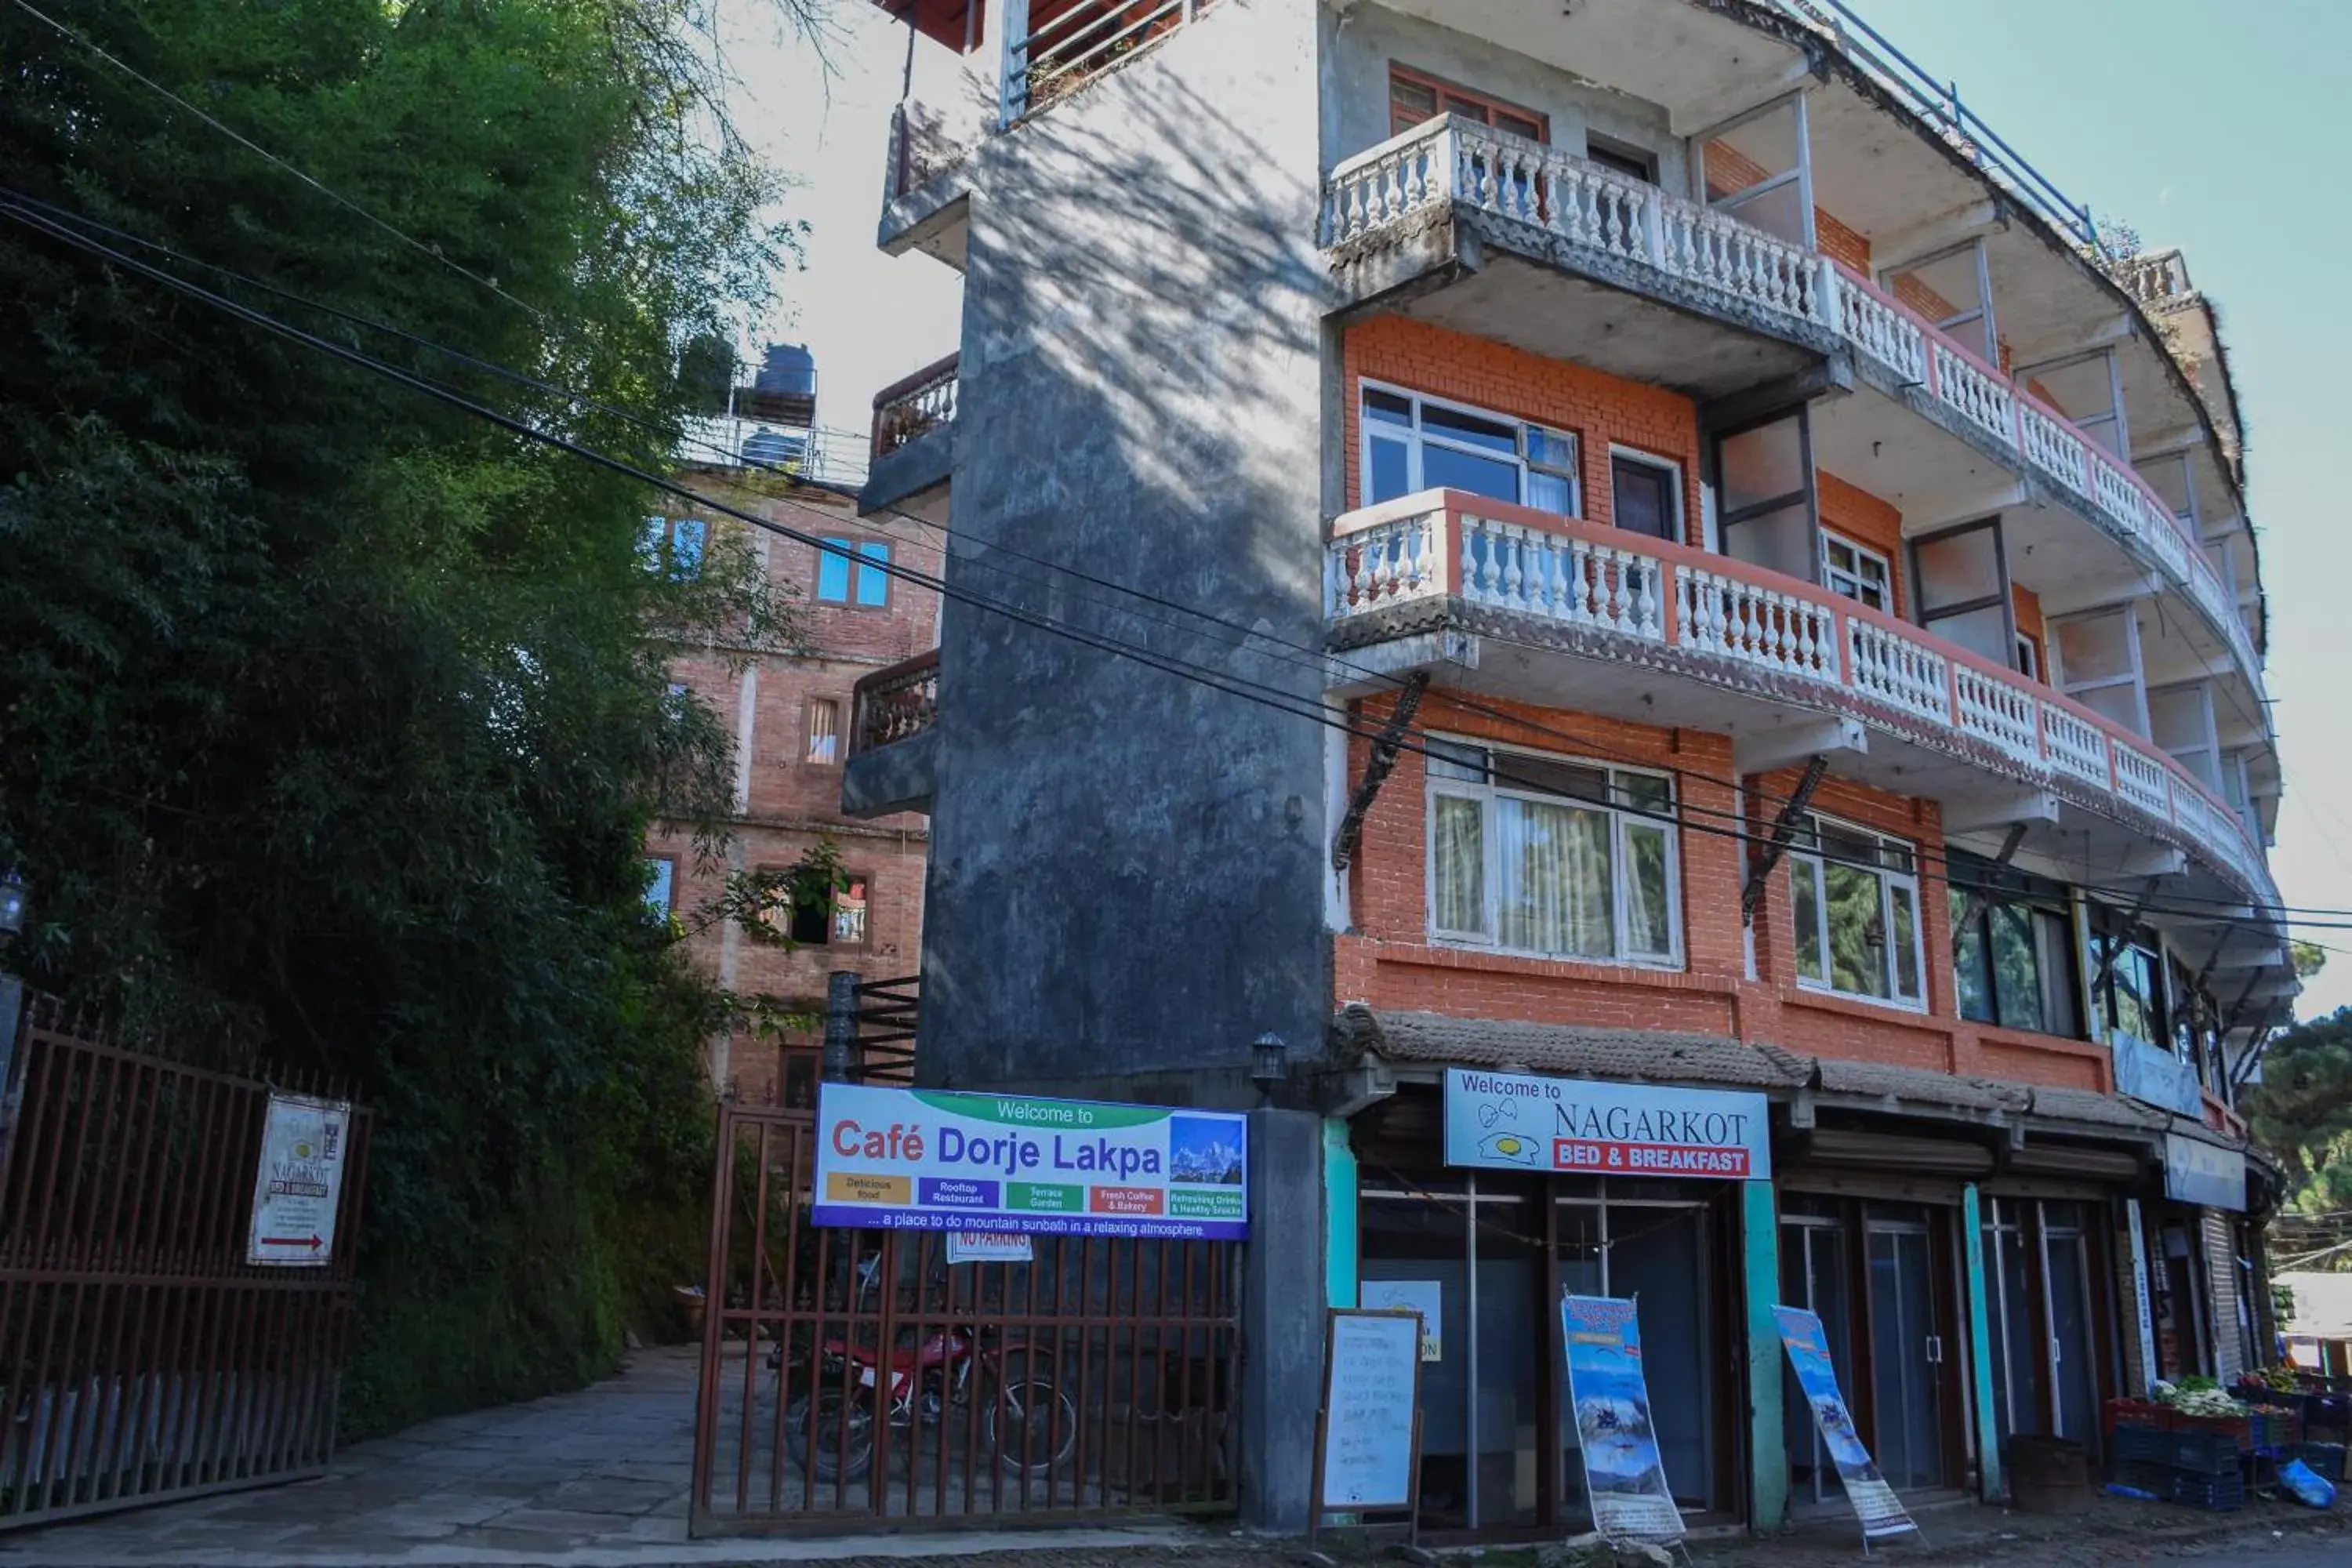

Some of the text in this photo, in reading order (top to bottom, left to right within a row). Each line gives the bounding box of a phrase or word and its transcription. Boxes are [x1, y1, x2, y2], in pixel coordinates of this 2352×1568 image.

[1462, 1073, 1561, 1099] Welcome to
[997, 1099, 1094, 1123] Welcome to
[1555, 1102, 1748, 1145] NAGARKOT
[832, 1119, 1161, 1181] Café Dorje Lakpa
[1559, 1143, 1744, 1172] BED & BREAKFAST
[846, 1177, 892, 1190] Delicious
[939, 1181, 978, 1195] Rooftop
[857, 1189, 880, 1200] food
[932, 1192, 984, 1204] Restaurant
[1030, 1186, 1063, 1198] Terrace
[1101, 1189, 1155, 1201] Fresh Coffee
[1029, 1197, 1063, 1208] Garden
[1108, 1201, 1147, 1212] & Bakery
[883, 1215, 891, 1226] a
[894, 1214, 927, 1229] place
[931, 1214, 943, 1228] to
[946, 1214, 961, 1228] do
[965, 1215, 1019, 1230] mountain
[1070, 1220, 1081, 1232] in
[1083, 1222, 1091, 1233] a
[1093, 1221, 1138, 1237] relaxing
[1140, 1223, 1203, 1238] atmosphere
